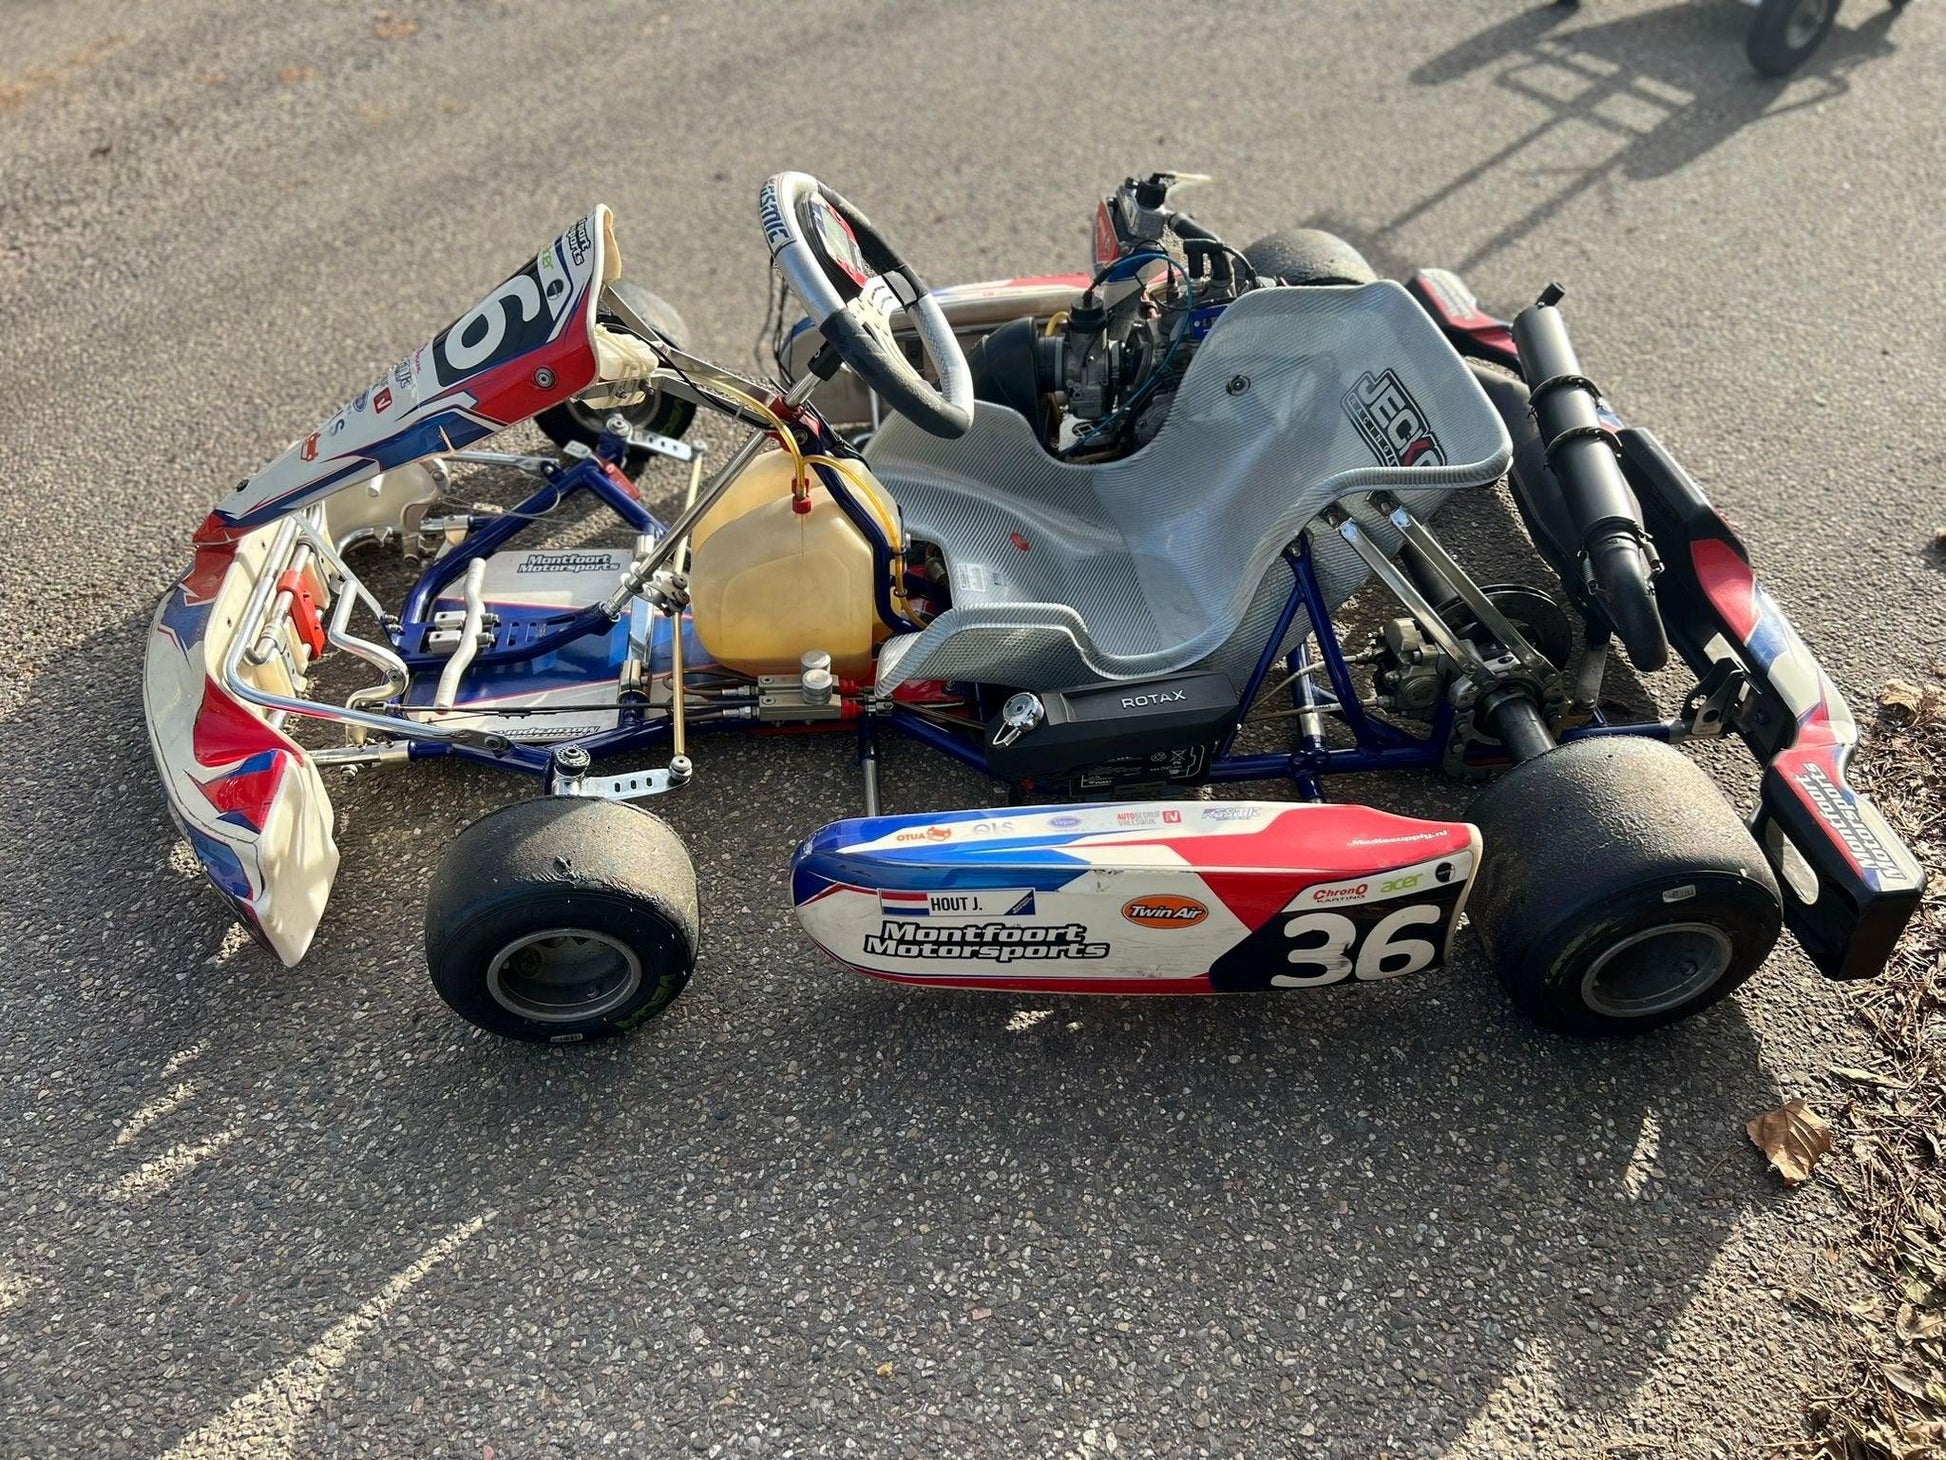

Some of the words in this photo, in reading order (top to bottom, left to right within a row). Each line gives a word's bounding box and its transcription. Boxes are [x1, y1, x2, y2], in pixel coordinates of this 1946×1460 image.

[517, 563, 620, 573] Motorsports
[527, 554, 612, 565] Montfoort
[1121, 689, 1187, 708] ROTAX
[1802, 762, 1907, 880] Motorsports
[1380, 872, 1424, 894] acer
[931, 897, 969, 912] HOUT
[972, 897, 984, 911] J.
[1129, 904, 1173, 918] Twin
[1173, 906, 1203, 919] Air
[883, 921, 1088, 943] Montfoort
[864, 934, 1111, 963] Motorsports
[1271, 904, 1441, 987] 36
